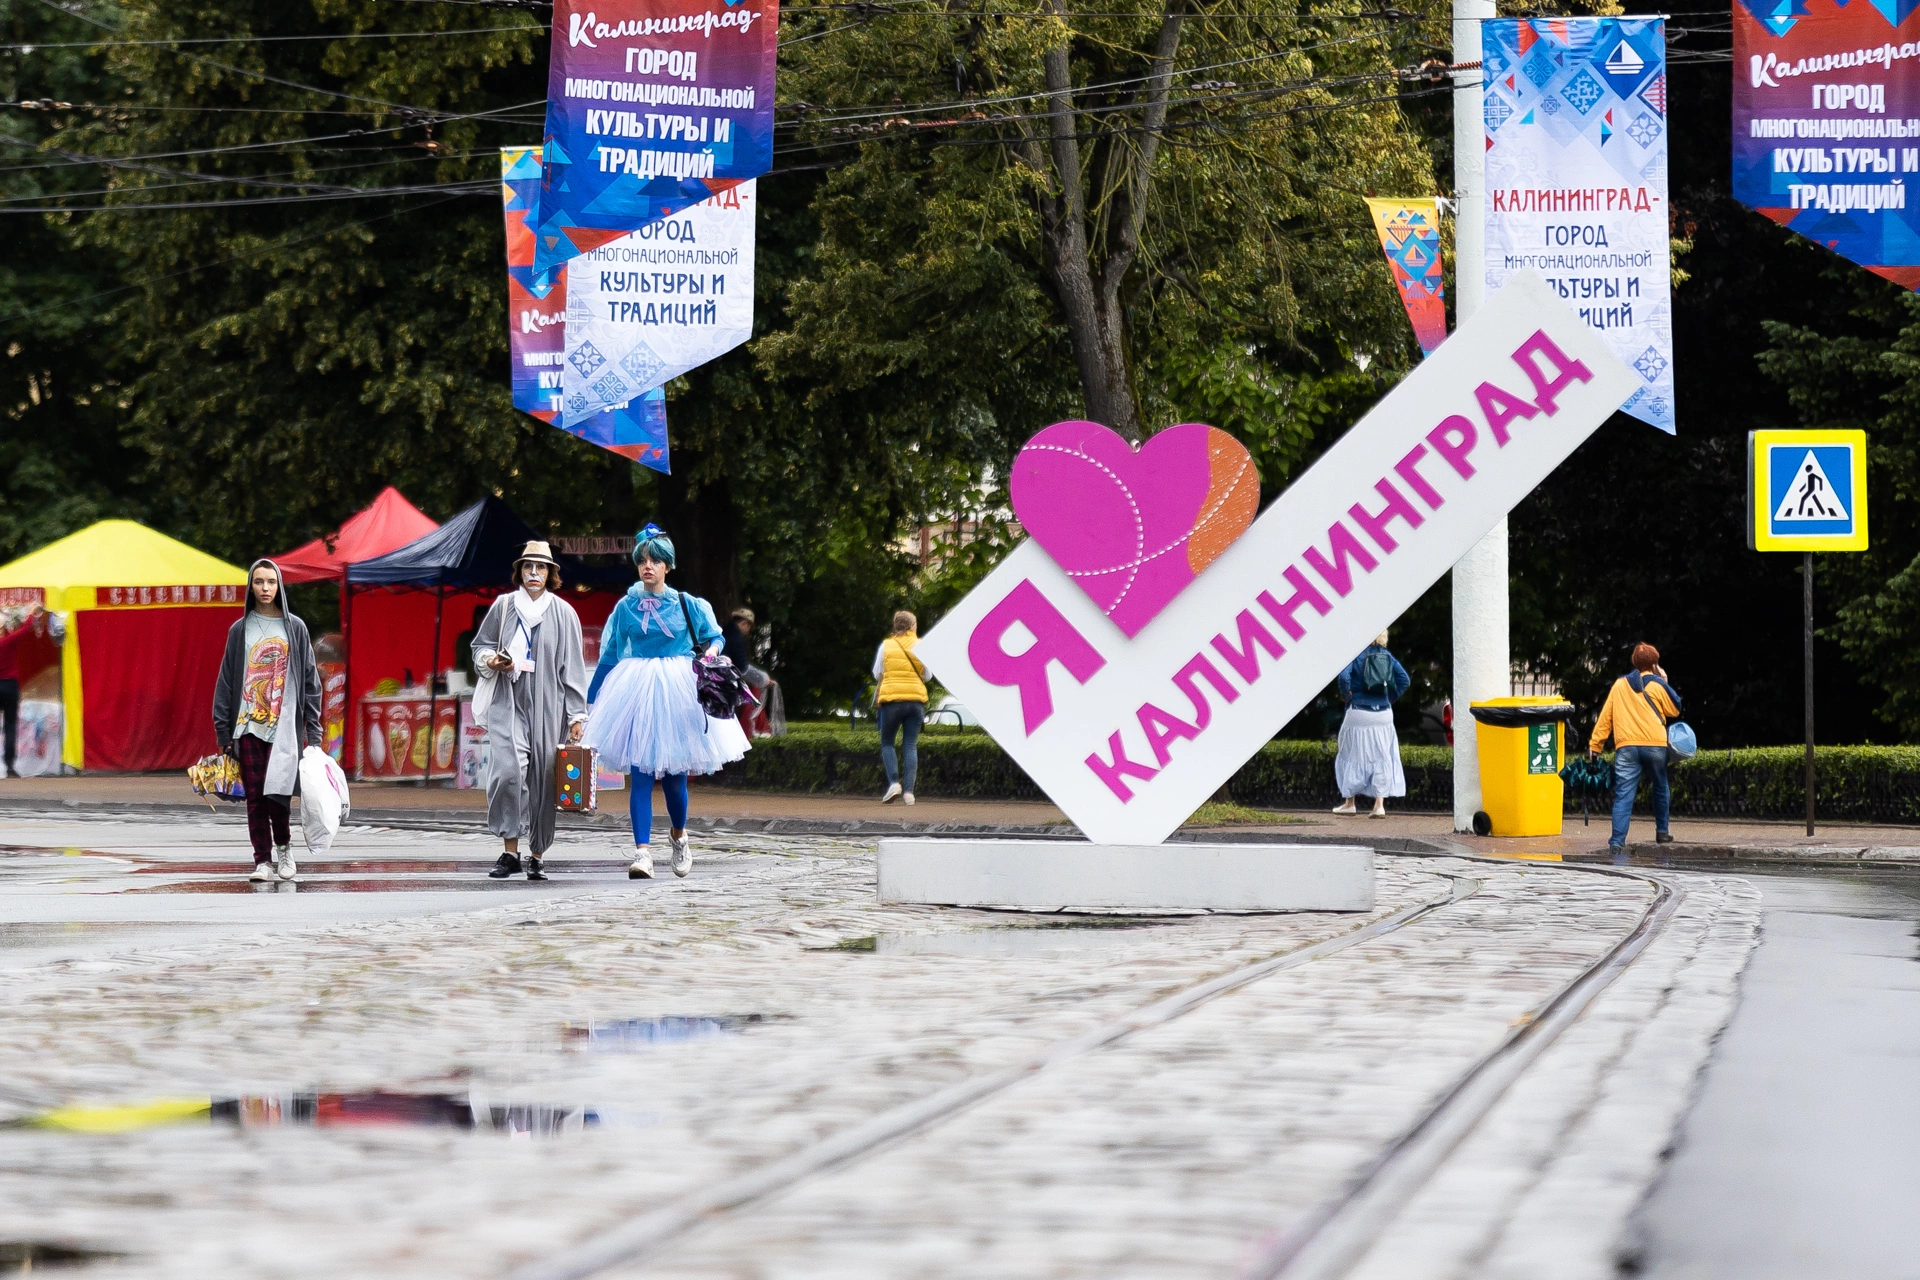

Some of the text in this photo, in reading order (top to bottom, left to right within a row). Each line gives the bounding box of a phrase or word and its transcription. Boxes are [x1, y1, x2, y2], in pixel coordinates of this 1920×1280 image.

[569, 9, 762, 48] Калининград-
[625, 47, 697, 82] ГОРОД
[1750, 41, 1920, 88] Калинингра
[564, 77, 755, 109] МНОГОНАЦИОНАЛЬНОЙ
[1812, 84, 1886, 114] ГОРОД
[585, 108, 730, 143] КУЛЬТУРЫ И
[1751, 118, 1920, 141] МНОГОНАЦИОНАЛЬН
[597, 146, 715, 182] ТРАДИЦИЙ
[1774, 147, 1919, 173] КУЛЬТУРЫ И
[1493, 187, 1660, 213] КАЛИНИНГРАД-
[1787, 179, 1905, 214] ТРАДИЦИЙ
[630, 220, 696, 243] ОРОД
[1545, 225, 1609, 248] ГОРОД
[600, 270, 725, 295] КУЛЬТУРЫ И
[1627, 277, 1640, 298] И
[607, 299, 717, 326] ТРАДИЦИЙ
[1084, 328, 1596, 805] КАЛИНИНГРАД
[967, 577, 1108, 738] Я
